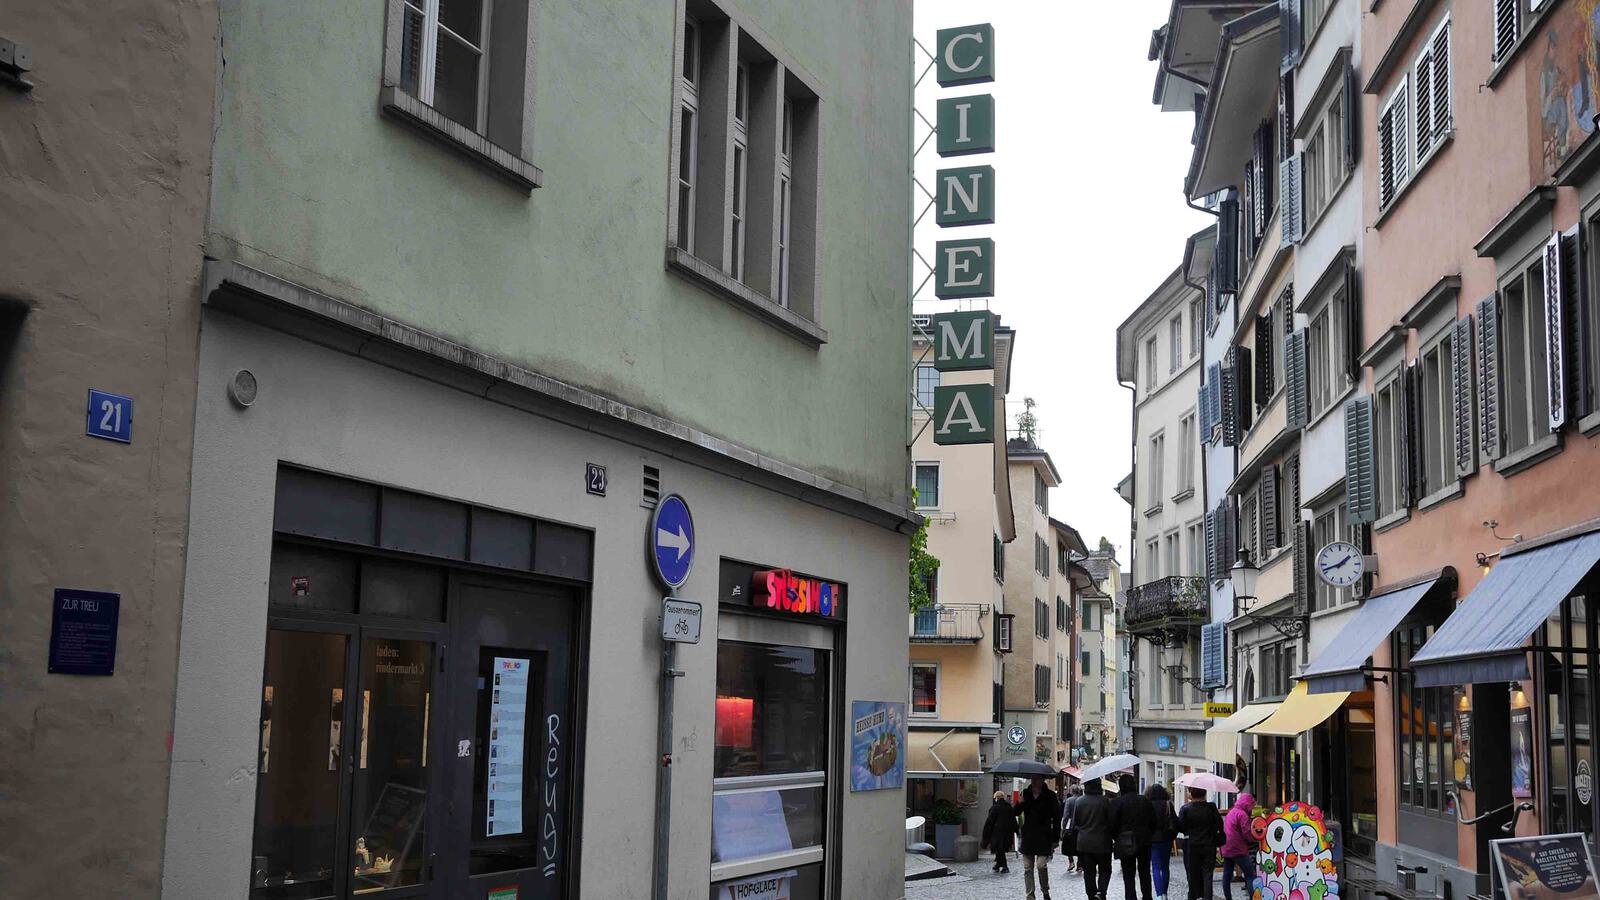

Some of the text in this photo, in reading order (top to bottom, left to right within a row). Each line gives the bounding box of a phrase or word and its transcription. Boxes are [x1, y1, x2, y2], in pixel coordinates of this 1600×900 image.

[937, 32, 986, 434] CINEMA
[100, 400, 122, 432] 21
[591, 467, 605, 490] 23
[63, 599, 99, 612] ZUR TREU
[375, 661, 418, 674] rindermarkt
[1209, 706, 1232, 714] CALIDA
[737, 879, 777, 899] HOF-GLACE
